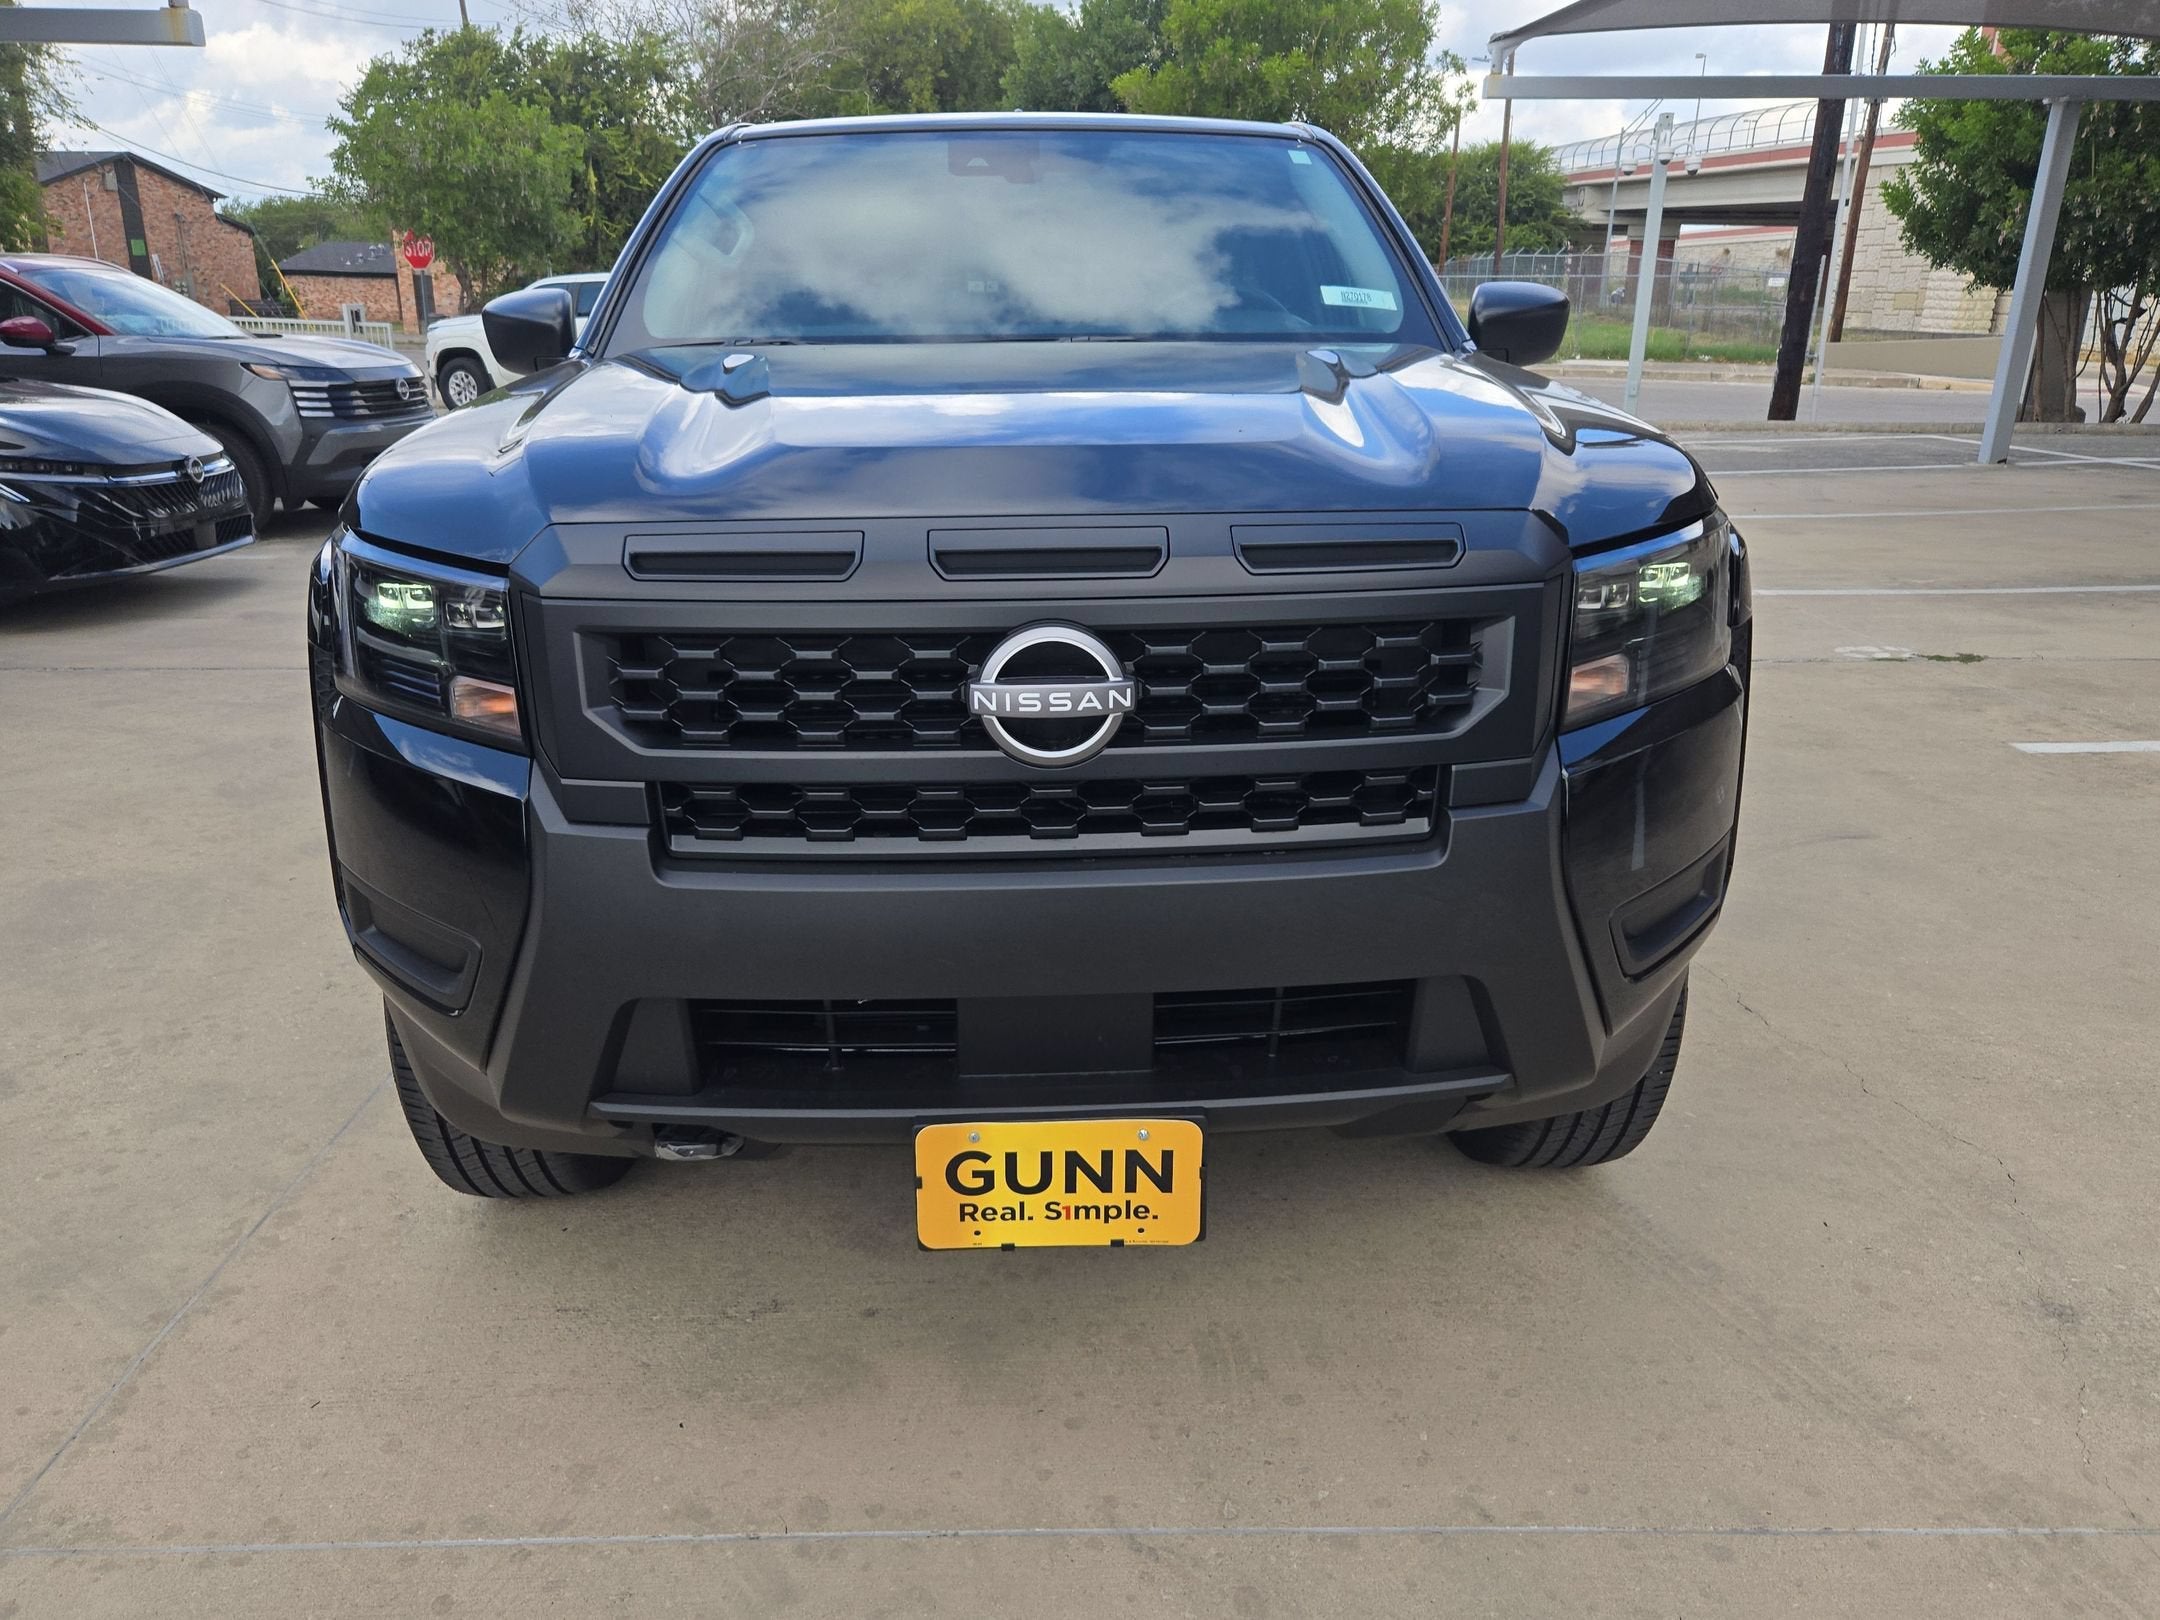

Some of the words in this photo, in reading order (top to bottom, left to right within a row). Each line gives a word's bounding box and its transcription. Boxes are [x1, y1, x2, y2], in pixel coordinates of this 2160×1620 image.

[973, 687, 1131, 712] NISSAN
[945, 1149, 1174, 1196] GUNN
[959, 1201, 1034, 1222] Real.
